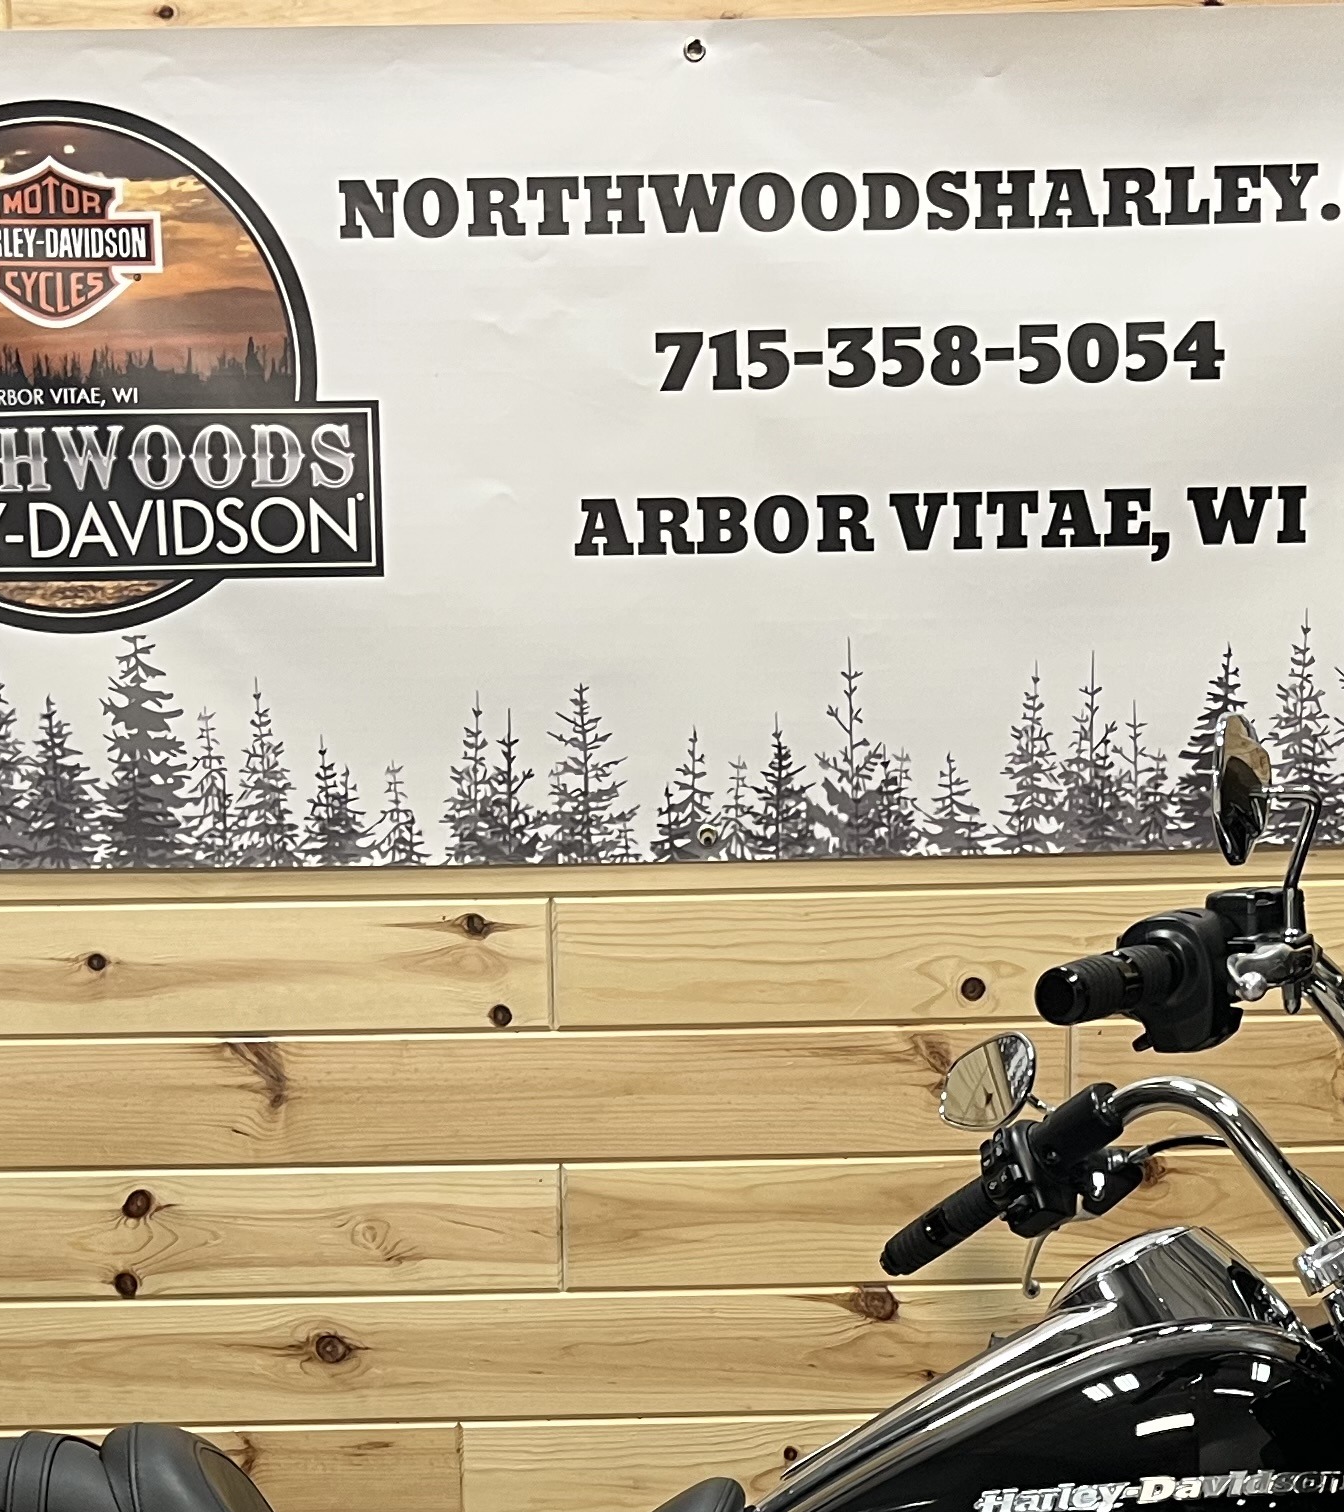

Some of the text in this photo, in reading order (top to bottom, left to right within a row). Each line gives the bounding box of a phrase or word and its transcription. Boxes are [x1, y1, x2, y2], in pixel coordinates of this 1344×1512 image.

[2, 175, 102, 215] MOTOR
[4, 270, 104, 313] CYCLES
[654, 320, 1226, 392] 715-358-5054
[49, 387, 106, 408] VITAE,
[111, 386, 139, 404] WI
[574, 485, 1308, 562] ARBOR VITAE, WI
